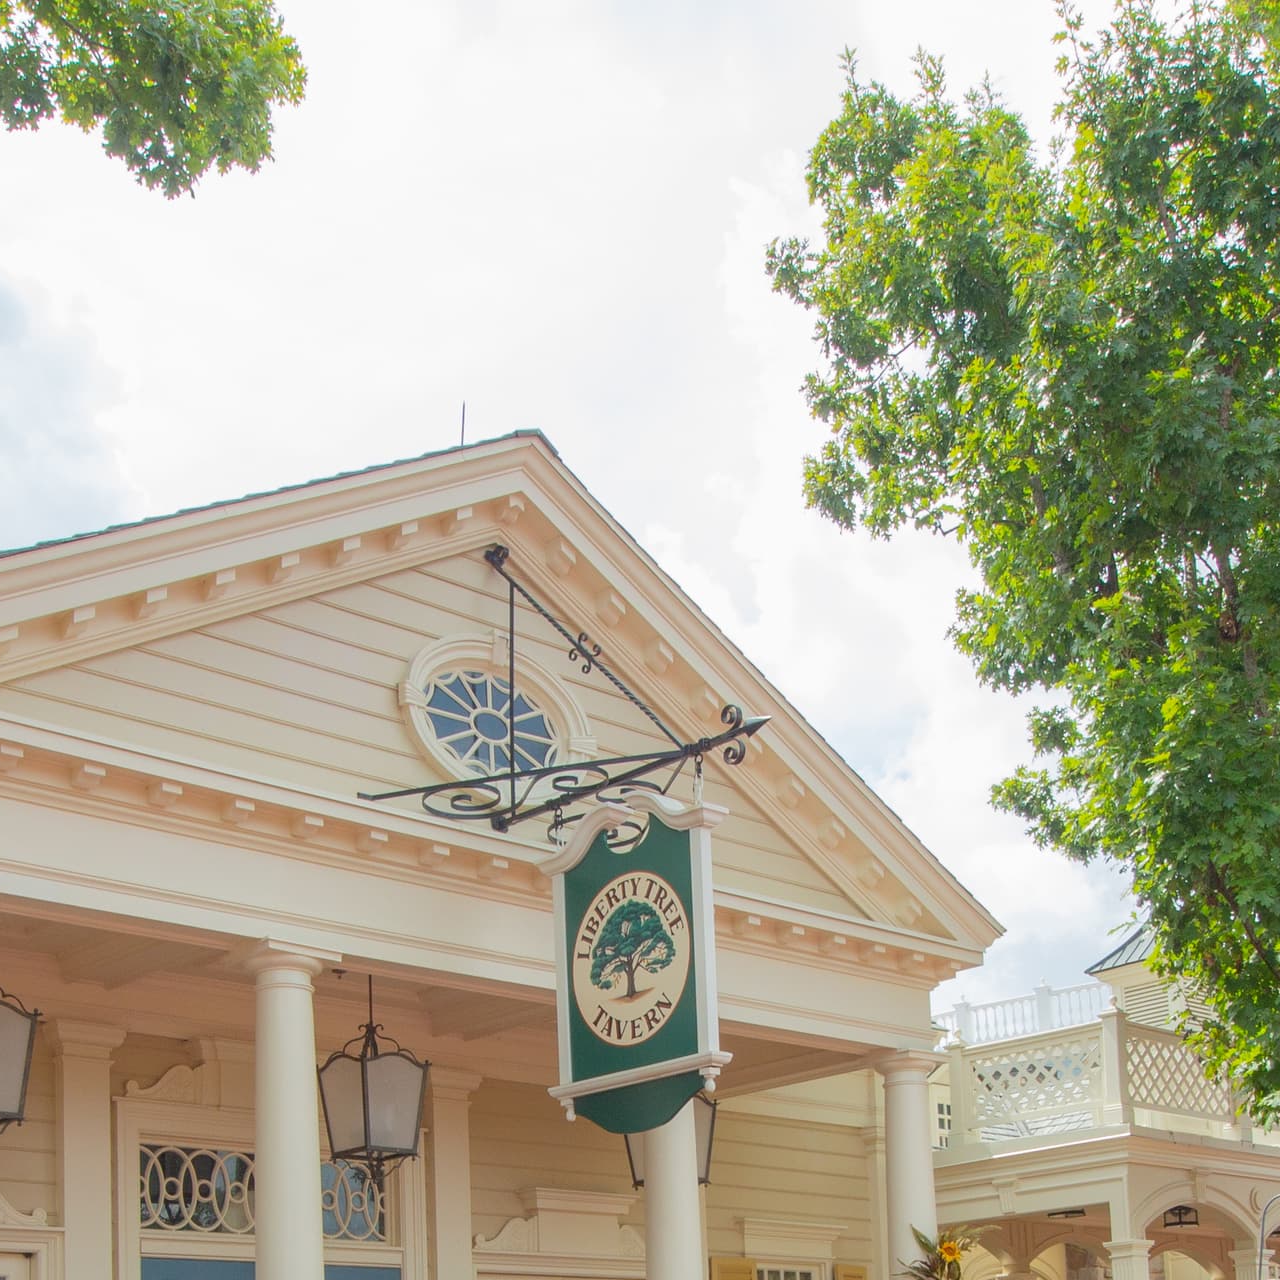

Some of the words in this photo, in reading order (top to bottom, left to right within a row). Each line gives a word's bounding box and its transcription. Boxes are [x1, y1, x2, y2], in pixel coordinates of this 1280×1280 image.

[577, 877, 641, 959] LIBERTY
[645, 878, 684, 936] TREE
[593, 992, 673, 1040] TAVERN
